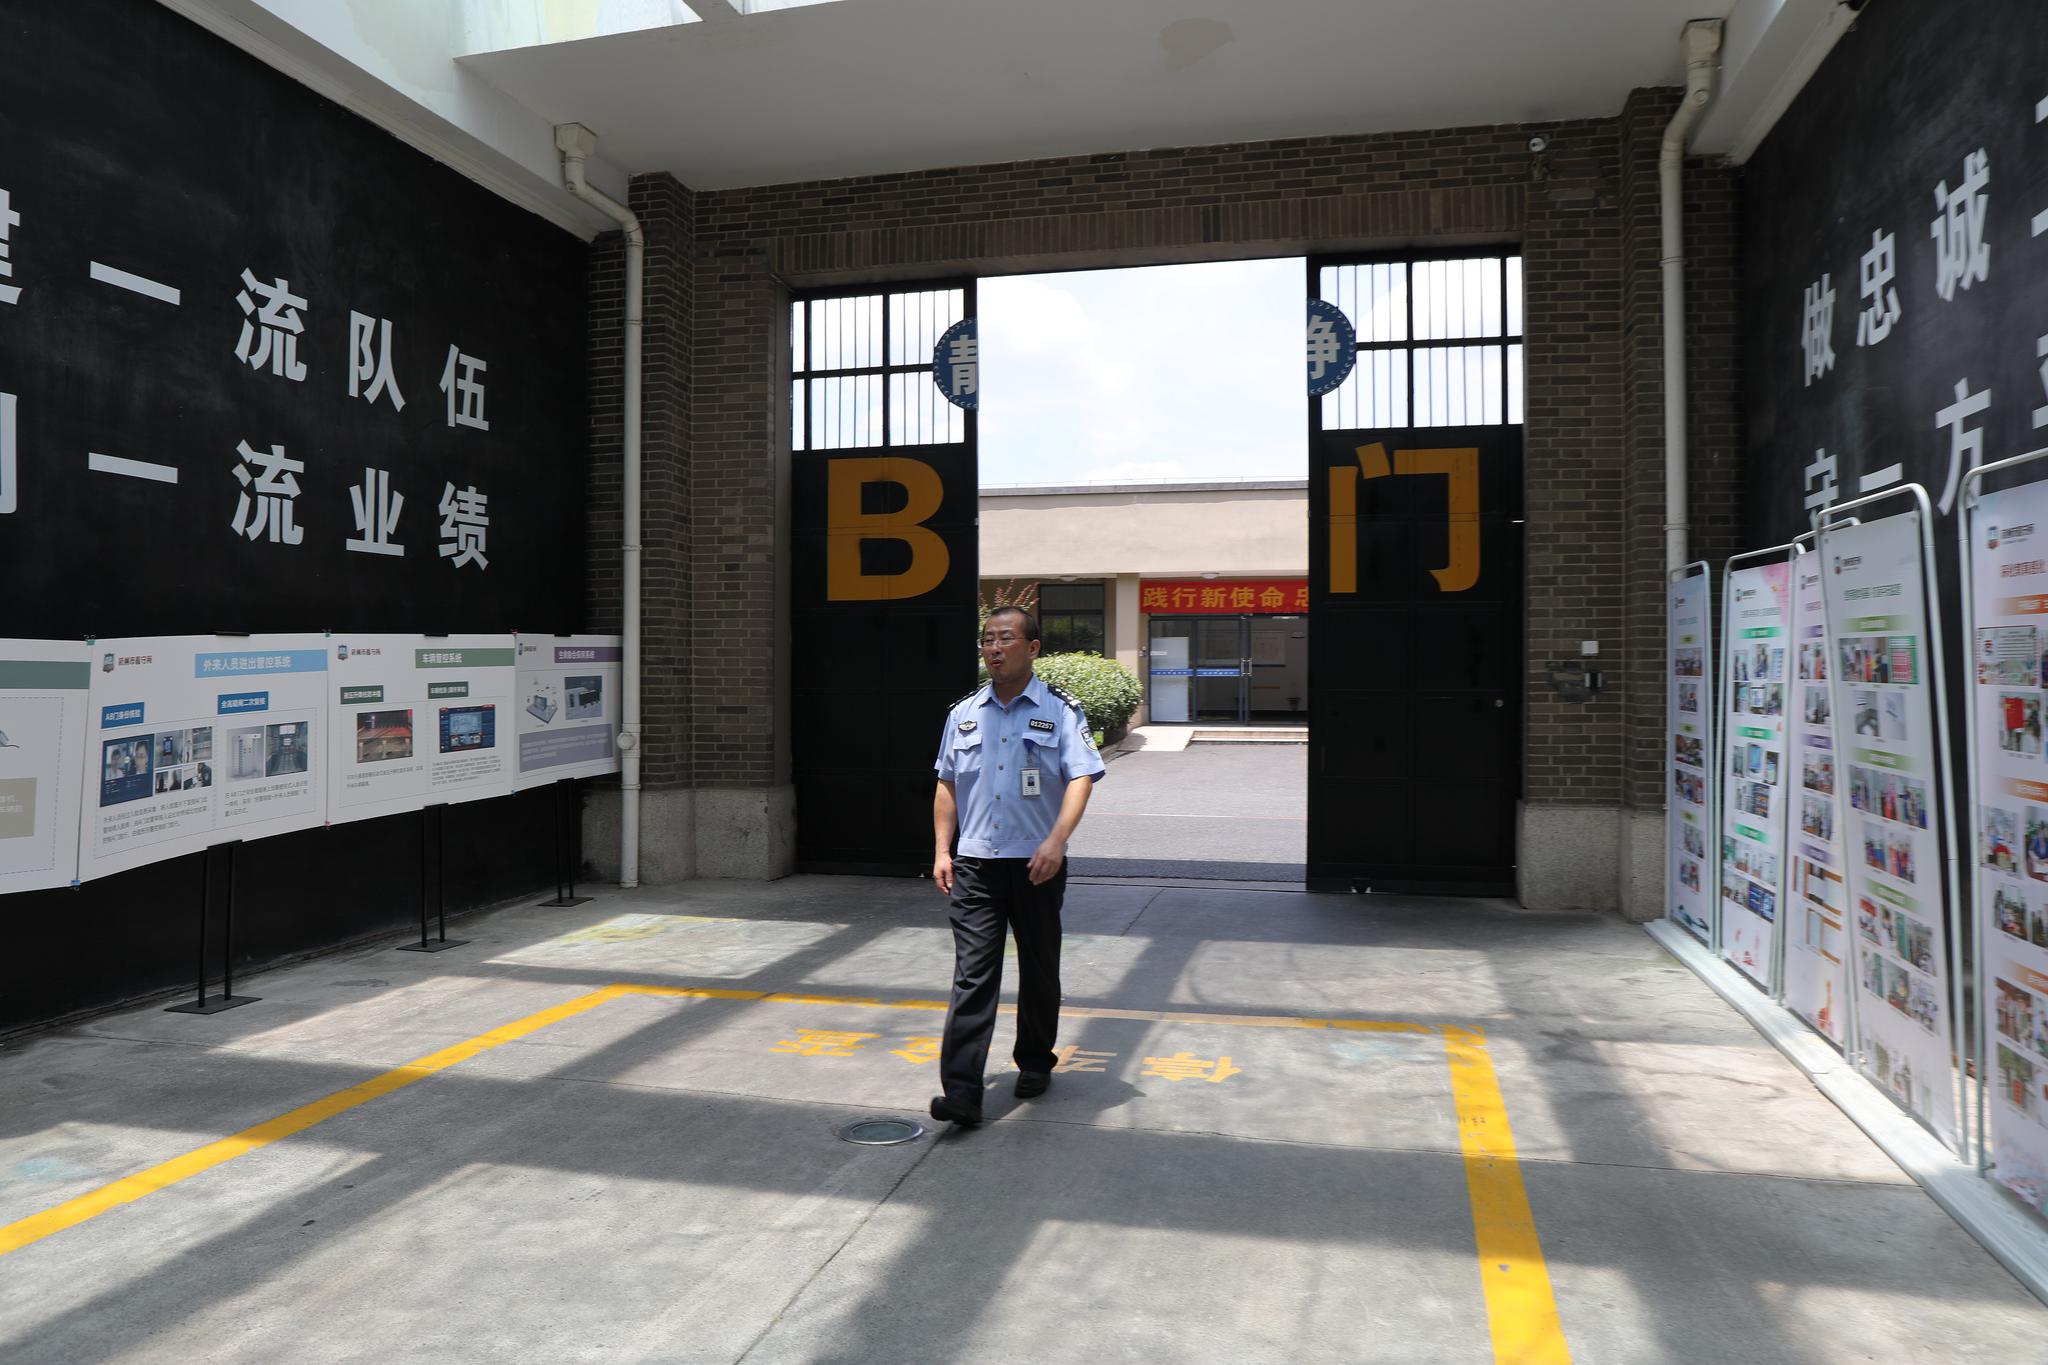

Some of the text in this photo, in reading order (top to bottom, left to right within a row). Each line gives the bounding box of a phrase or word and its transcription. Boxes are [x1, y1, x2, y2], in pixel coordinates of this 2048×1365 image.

[0, 392, 490, 570] 一流业绩
[827, 457, 950, 601] B
[1329, 442, 1481, 593] 门
[1143, 586, 1286, 608] 践行新使命
